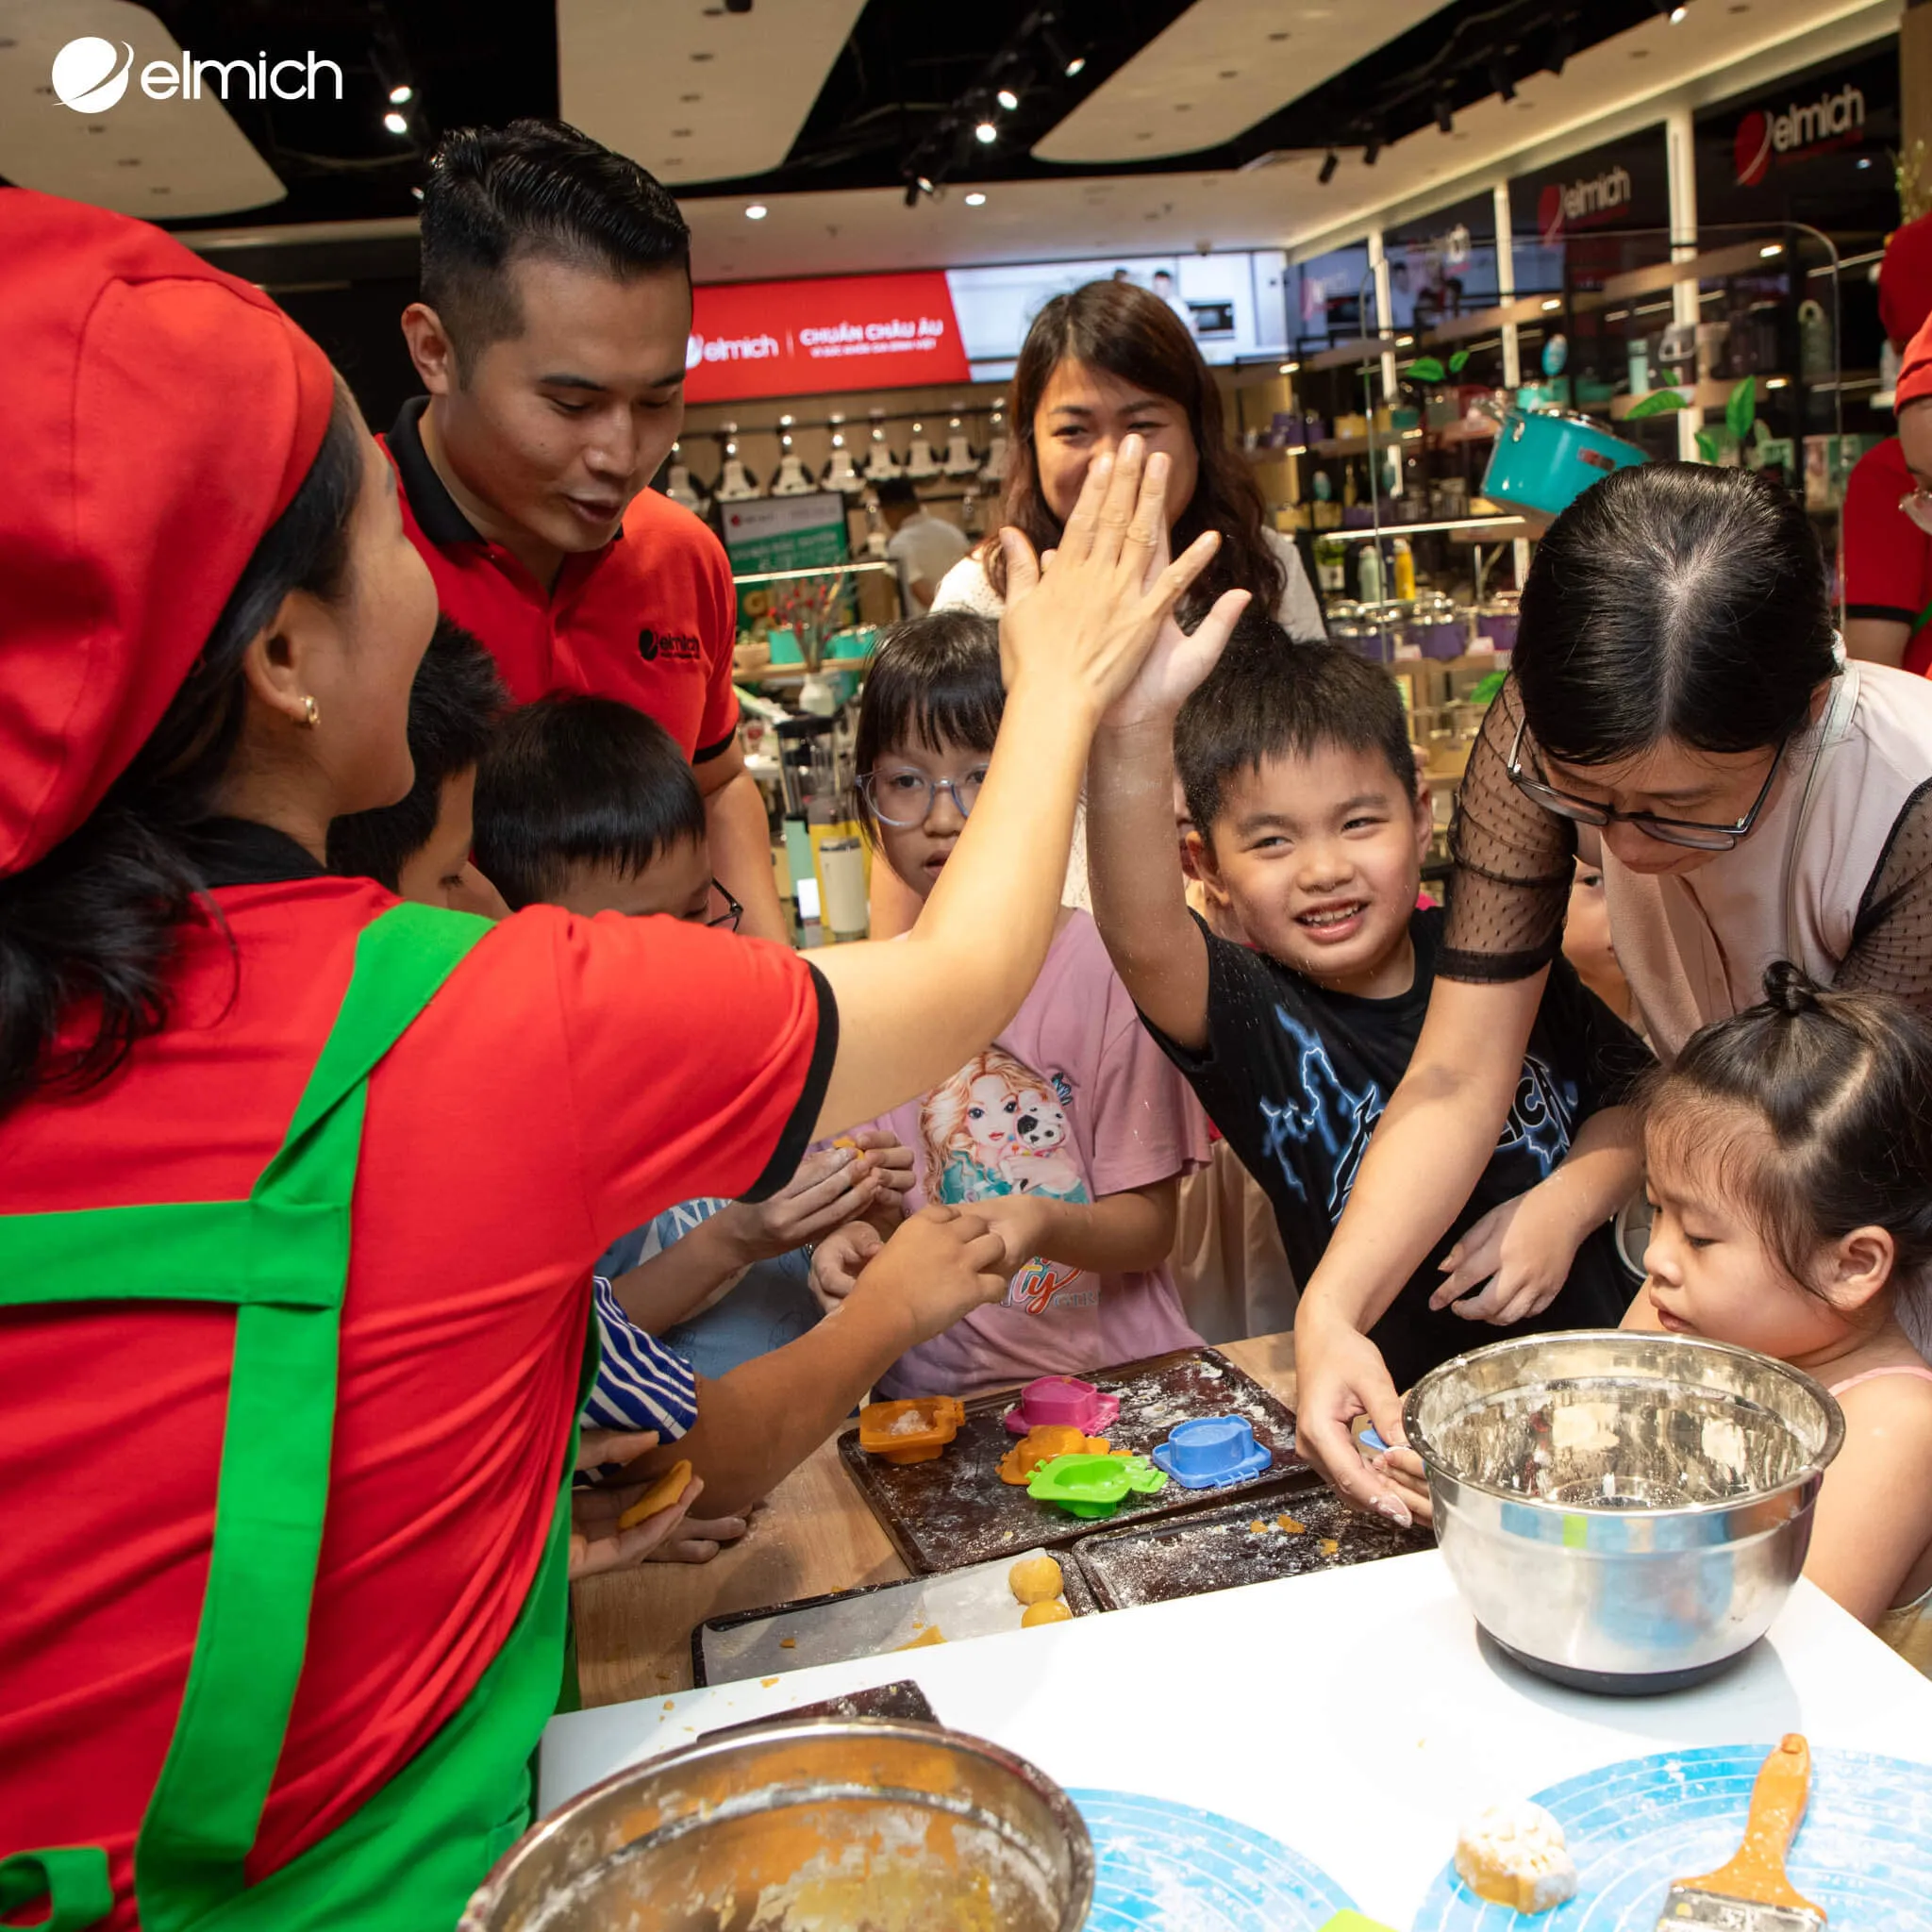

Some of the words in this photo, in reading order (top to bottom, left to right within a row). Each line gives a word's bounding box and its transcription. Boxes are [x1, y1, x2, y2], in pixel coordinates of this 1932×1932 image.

[1773, 83, 1865, 153] elmich
[1564, 165, 1631, 220] elmich
[704, 333, 779, 362] elmich
